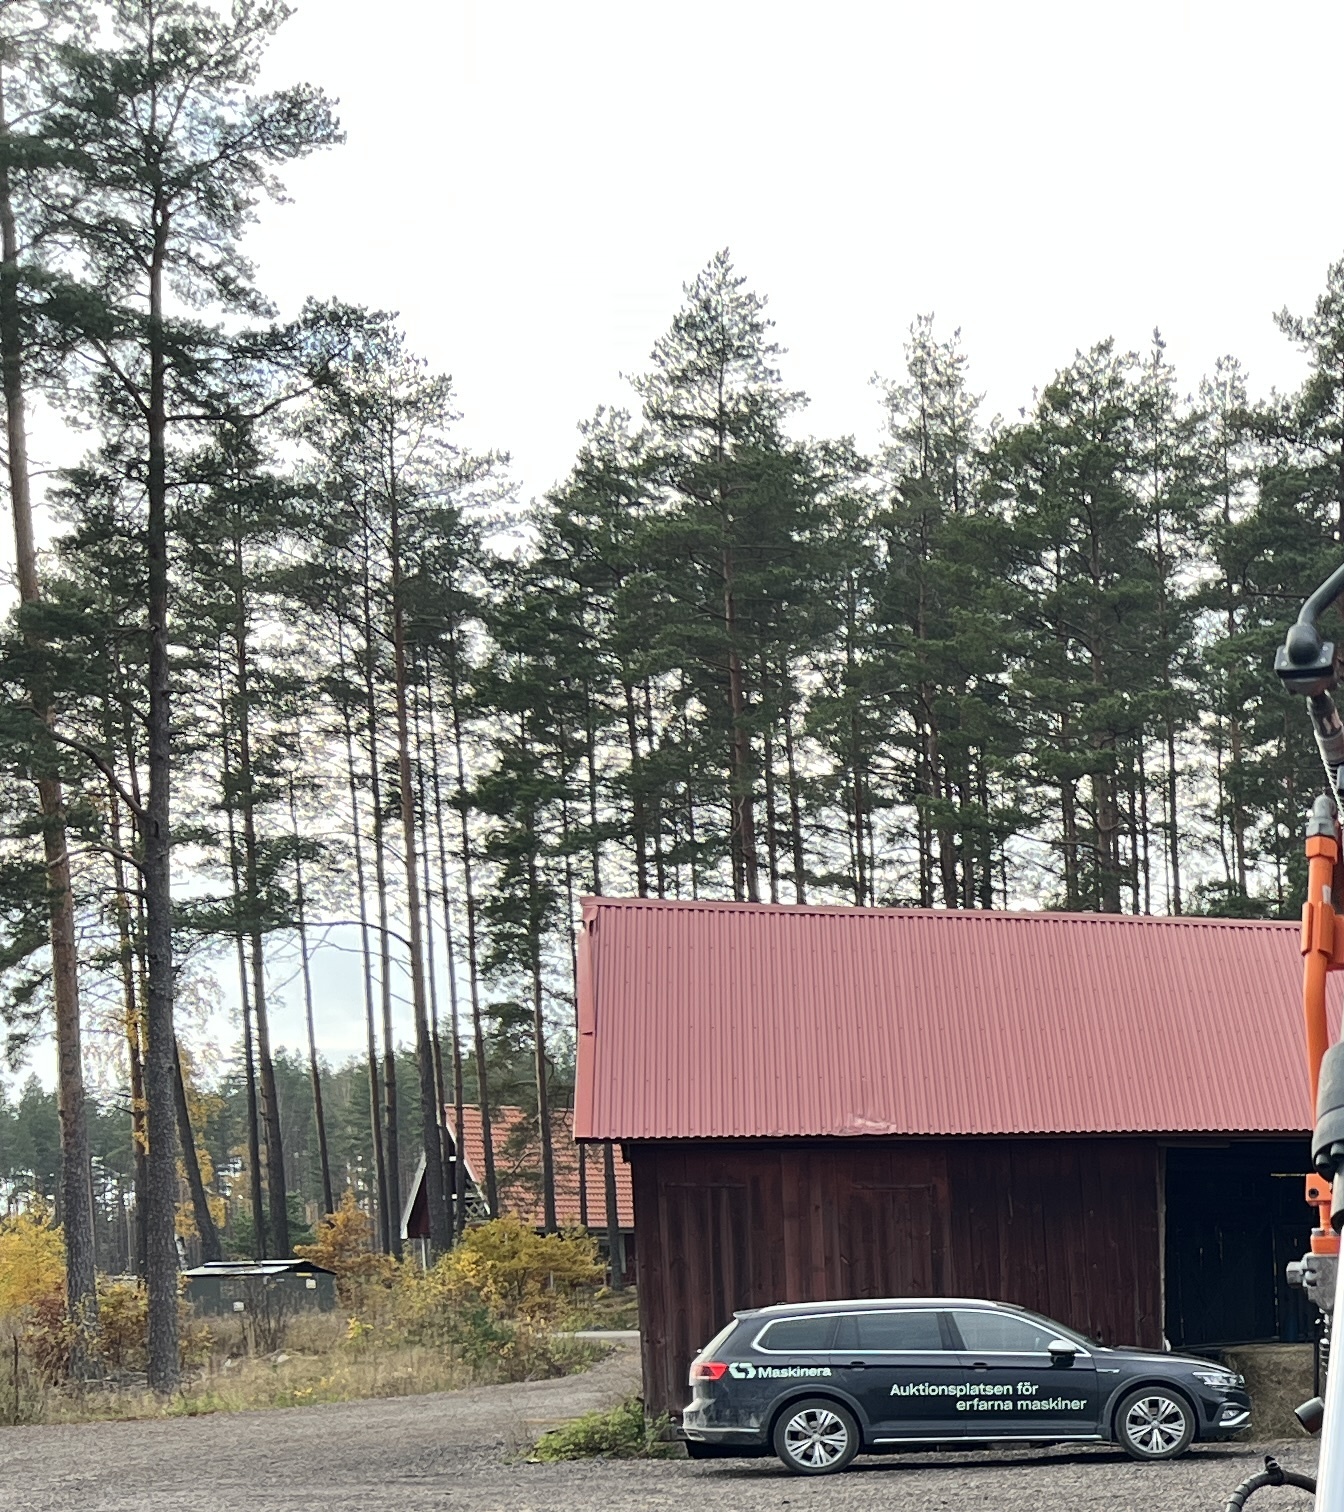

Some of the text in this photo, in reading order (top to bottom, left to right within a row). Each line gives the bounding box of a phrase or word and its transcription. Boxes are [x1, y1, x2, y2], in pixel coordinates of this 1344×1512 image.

[758, 1366, 832, 1378] Maskinera
[890, 1382, 1039, 1397] Auktionsplatsen för
[956, 1397, 1087, 1411] erfarna maskiner
